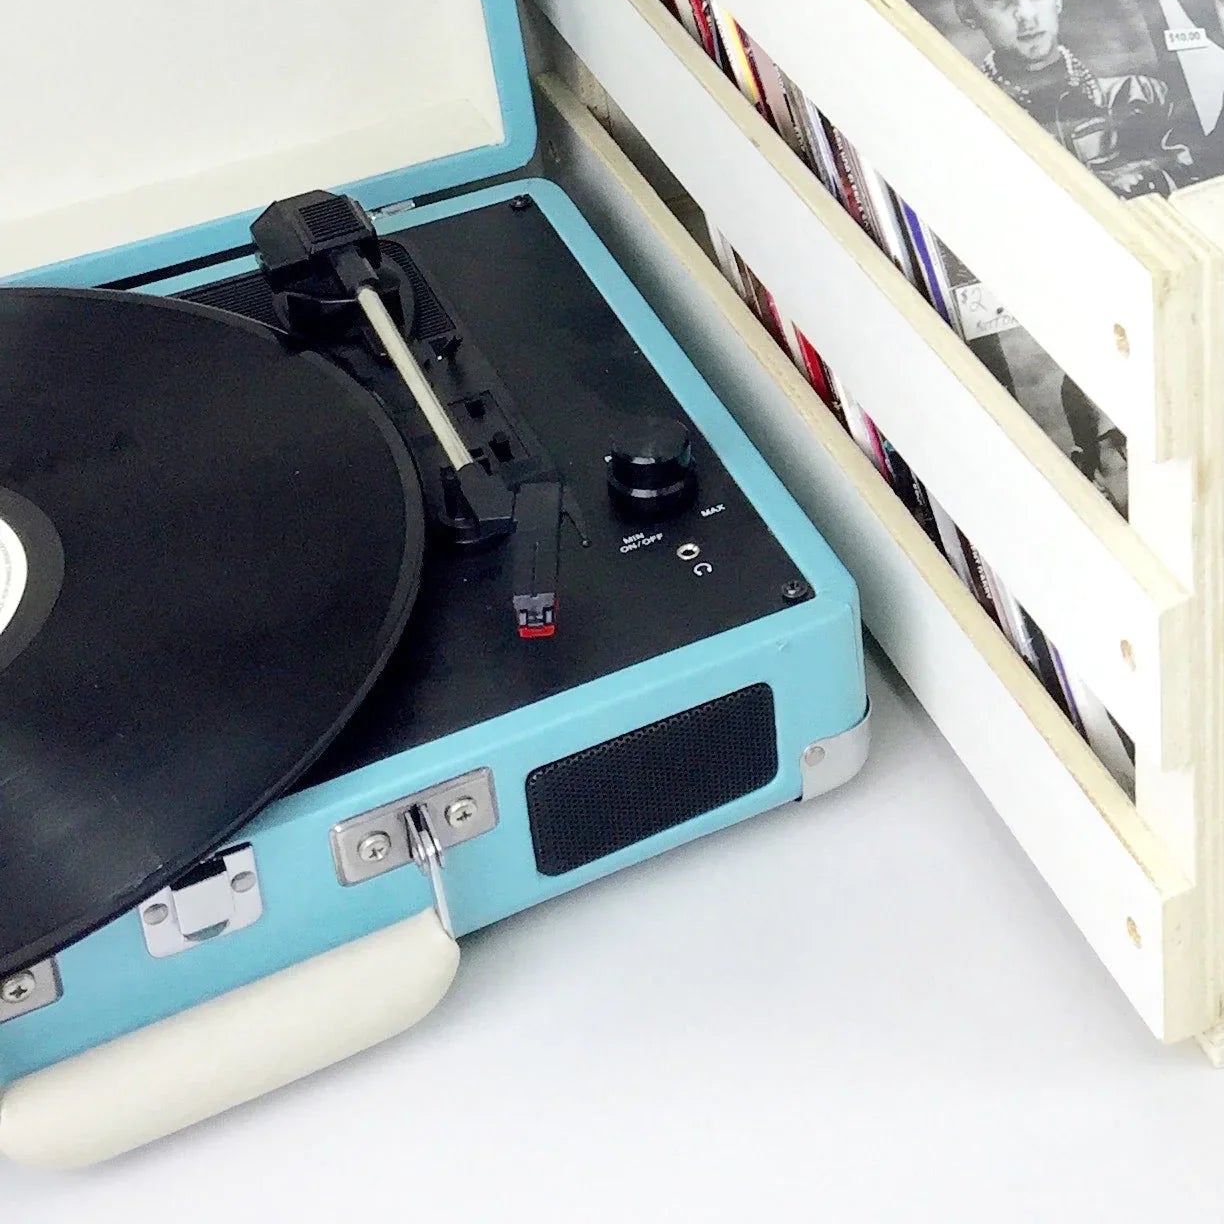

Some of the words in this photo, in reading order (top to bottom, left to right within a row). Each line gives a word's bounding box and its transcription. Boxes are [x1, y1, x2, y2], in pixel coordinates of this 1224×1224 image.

[700, 503, 726, 517] MAX
[619, 532, 663, 554] ON/OFF
[622, 532, 645, 545] MIN
